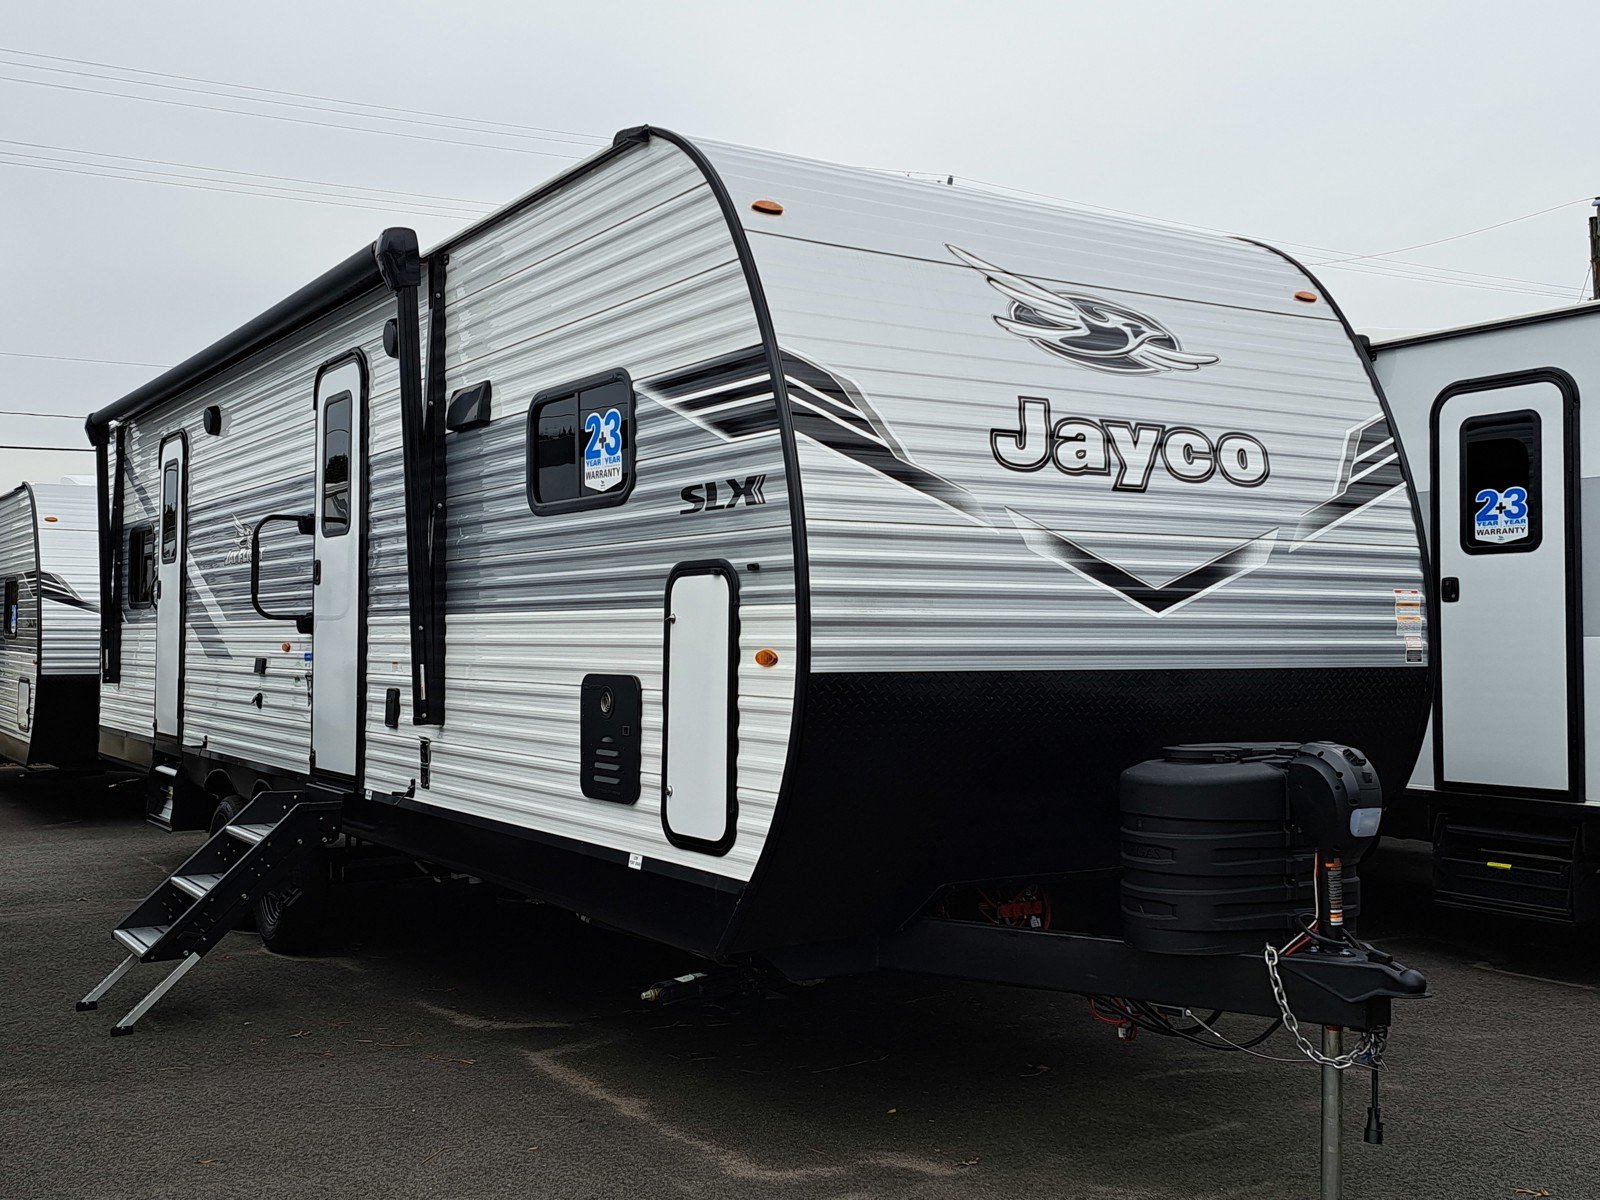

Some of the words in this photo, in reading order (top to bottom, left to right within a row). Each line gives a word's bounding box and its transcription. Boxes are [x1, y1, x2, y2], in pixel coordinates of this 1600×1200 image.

[989, 395, 1271, 493] Jayco
[586, 459, 602, 468] YEAR
[604, 455, 621, 465] YEAR
[586, 467, 621, 481] WARRANTY
[680, 474, 767, 515] SLX
[1503, 518, 1527, 526] YEAR
[1476, 526, 1526, 537] WARRANTY
